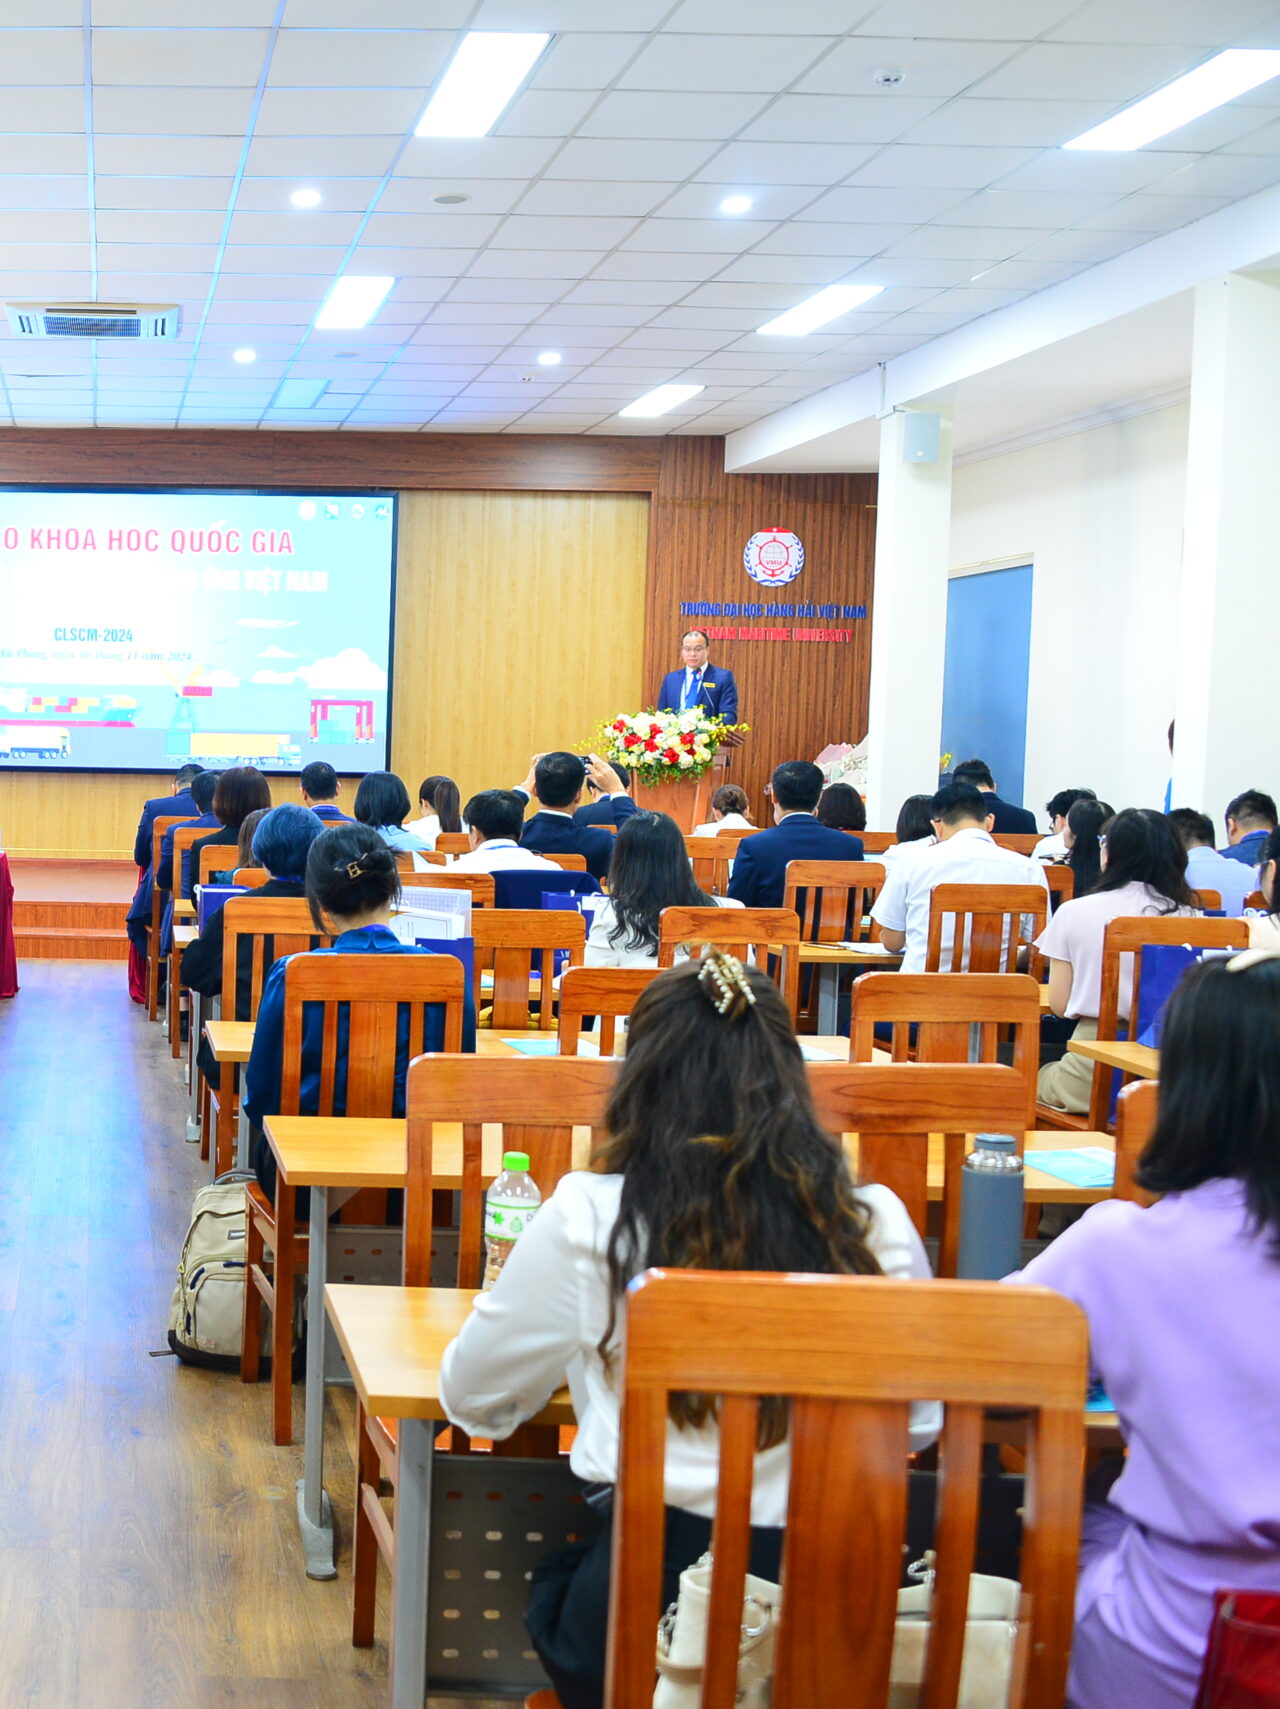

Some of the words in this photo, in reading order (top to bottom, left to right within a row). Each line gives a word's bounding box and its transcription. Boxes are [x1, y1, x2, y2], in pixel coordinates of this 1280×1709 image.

[30, 528, 97, 550] KHOA
[171, 520, 240, 554] QUỐC
[251, 530, 294, 553] GIA
[286, 570, 329, 592] NAM
[765, 600, 794, 617] HÀNG
[841, 605, 867, 619] NAM
[54, 627, 134, 643] CLSCM-2024
[690, 626, 737, 641] TNAM
[739, 626, 791, 641] MARITIME
[793, 628, 854, 643] UNIVERSITY
